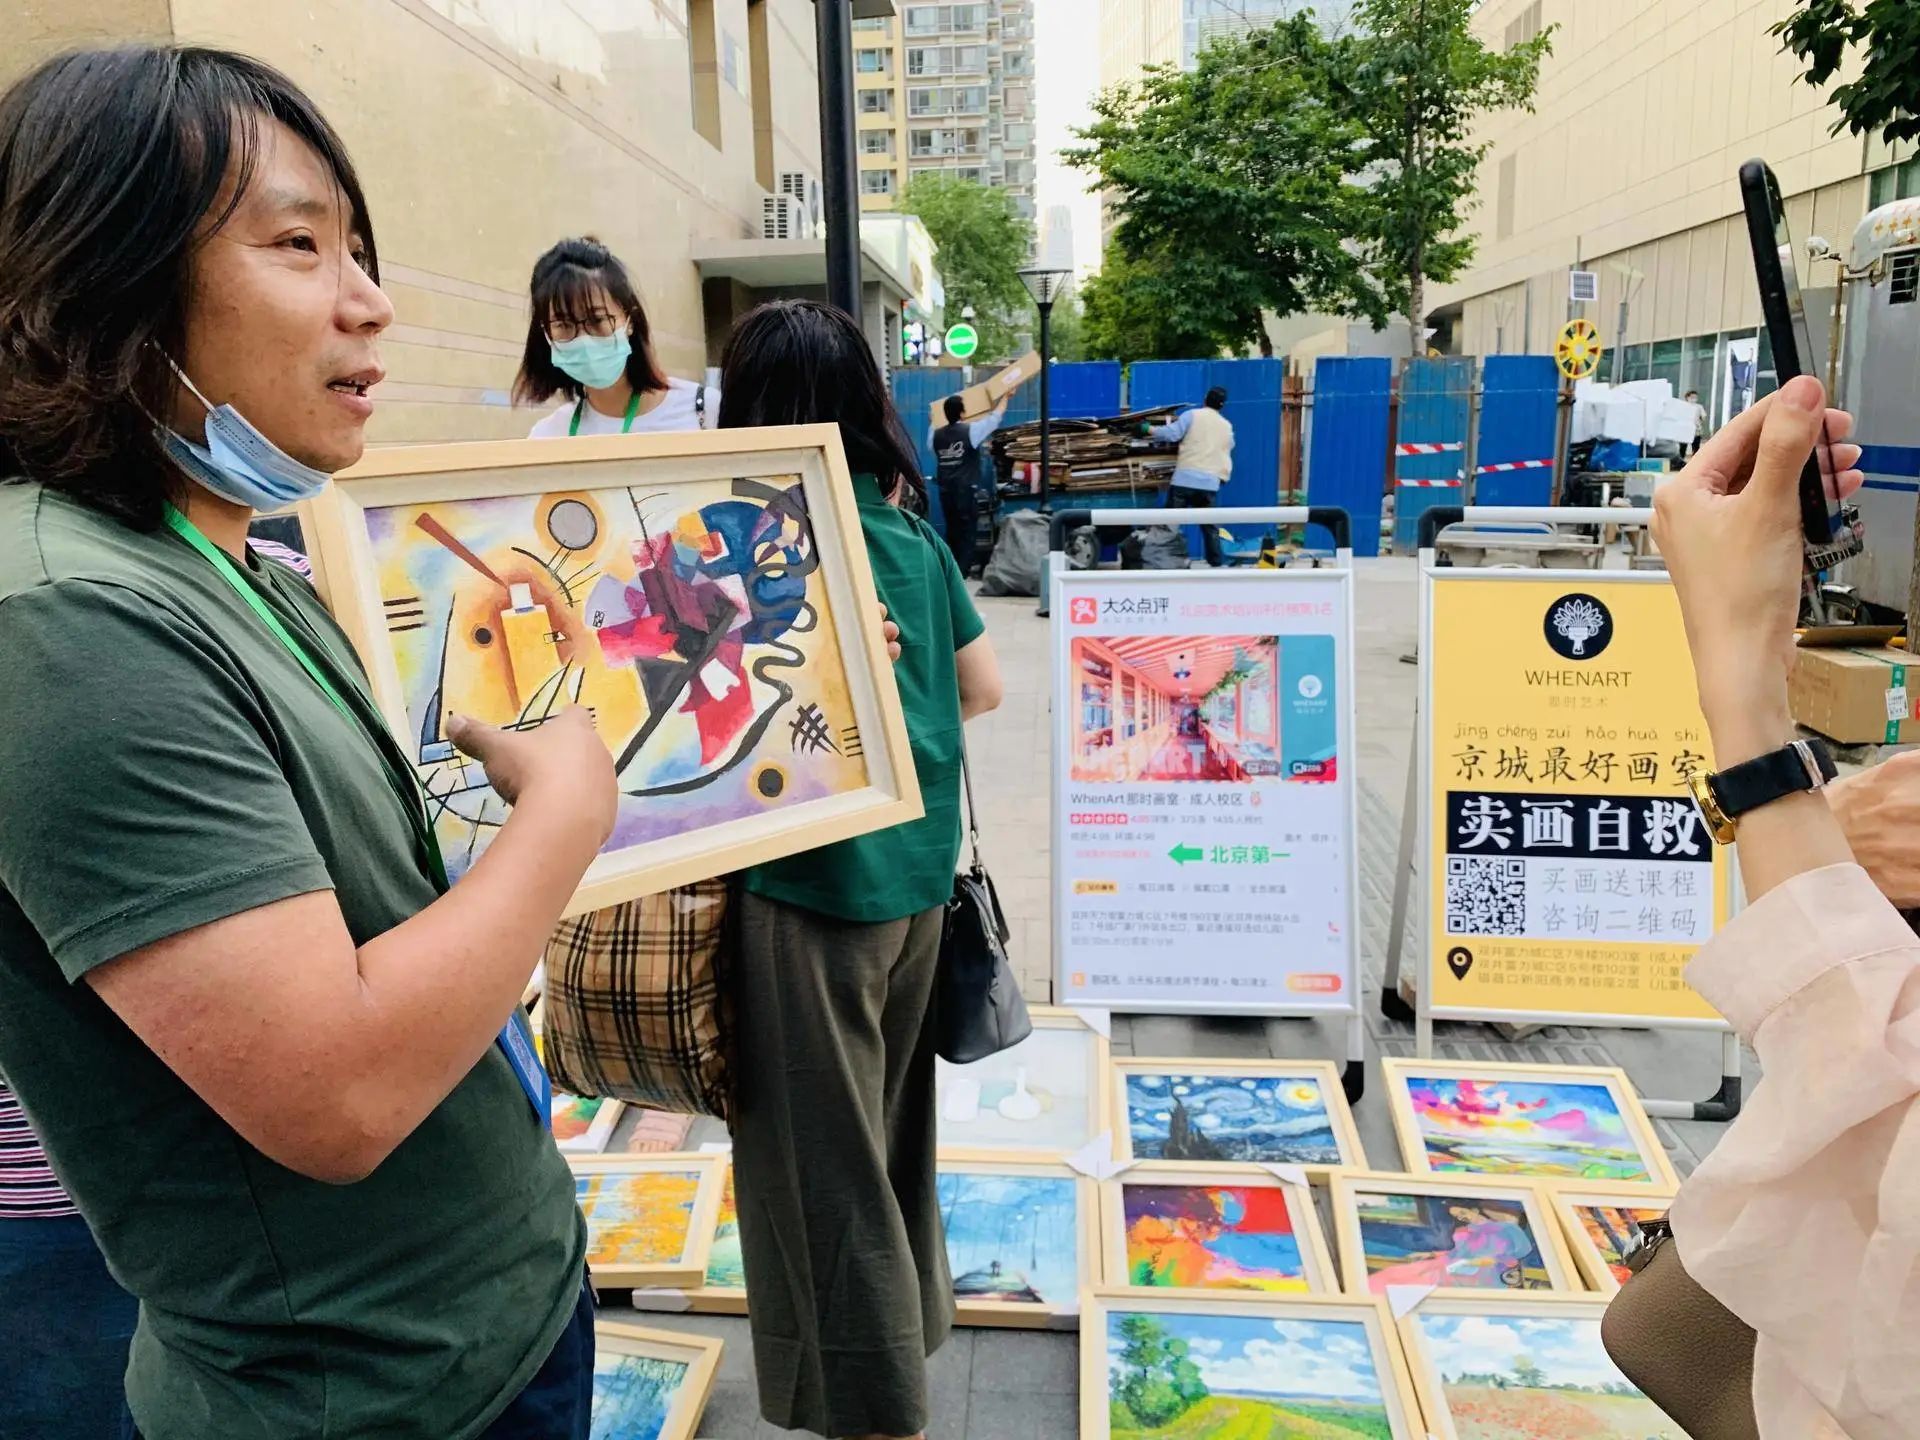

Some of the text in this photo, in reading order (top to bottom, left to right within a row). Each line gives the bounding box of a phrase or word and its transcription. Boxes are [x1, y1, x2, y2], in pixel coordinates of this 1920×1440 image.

[1102, 597, 1169, 614] 大众点评
[1524, 669, 1632, 687] WHENART
[1452, 744, 1706, 787] 京城最好画室
[1458, 795, 1700, 856] 卖画自救
[1210, 846, 1291, 865] 北京第一
[1541, 866, 1698, 899] 买画送课程
[1542, 903, 1696, 937] 咨询二维码
